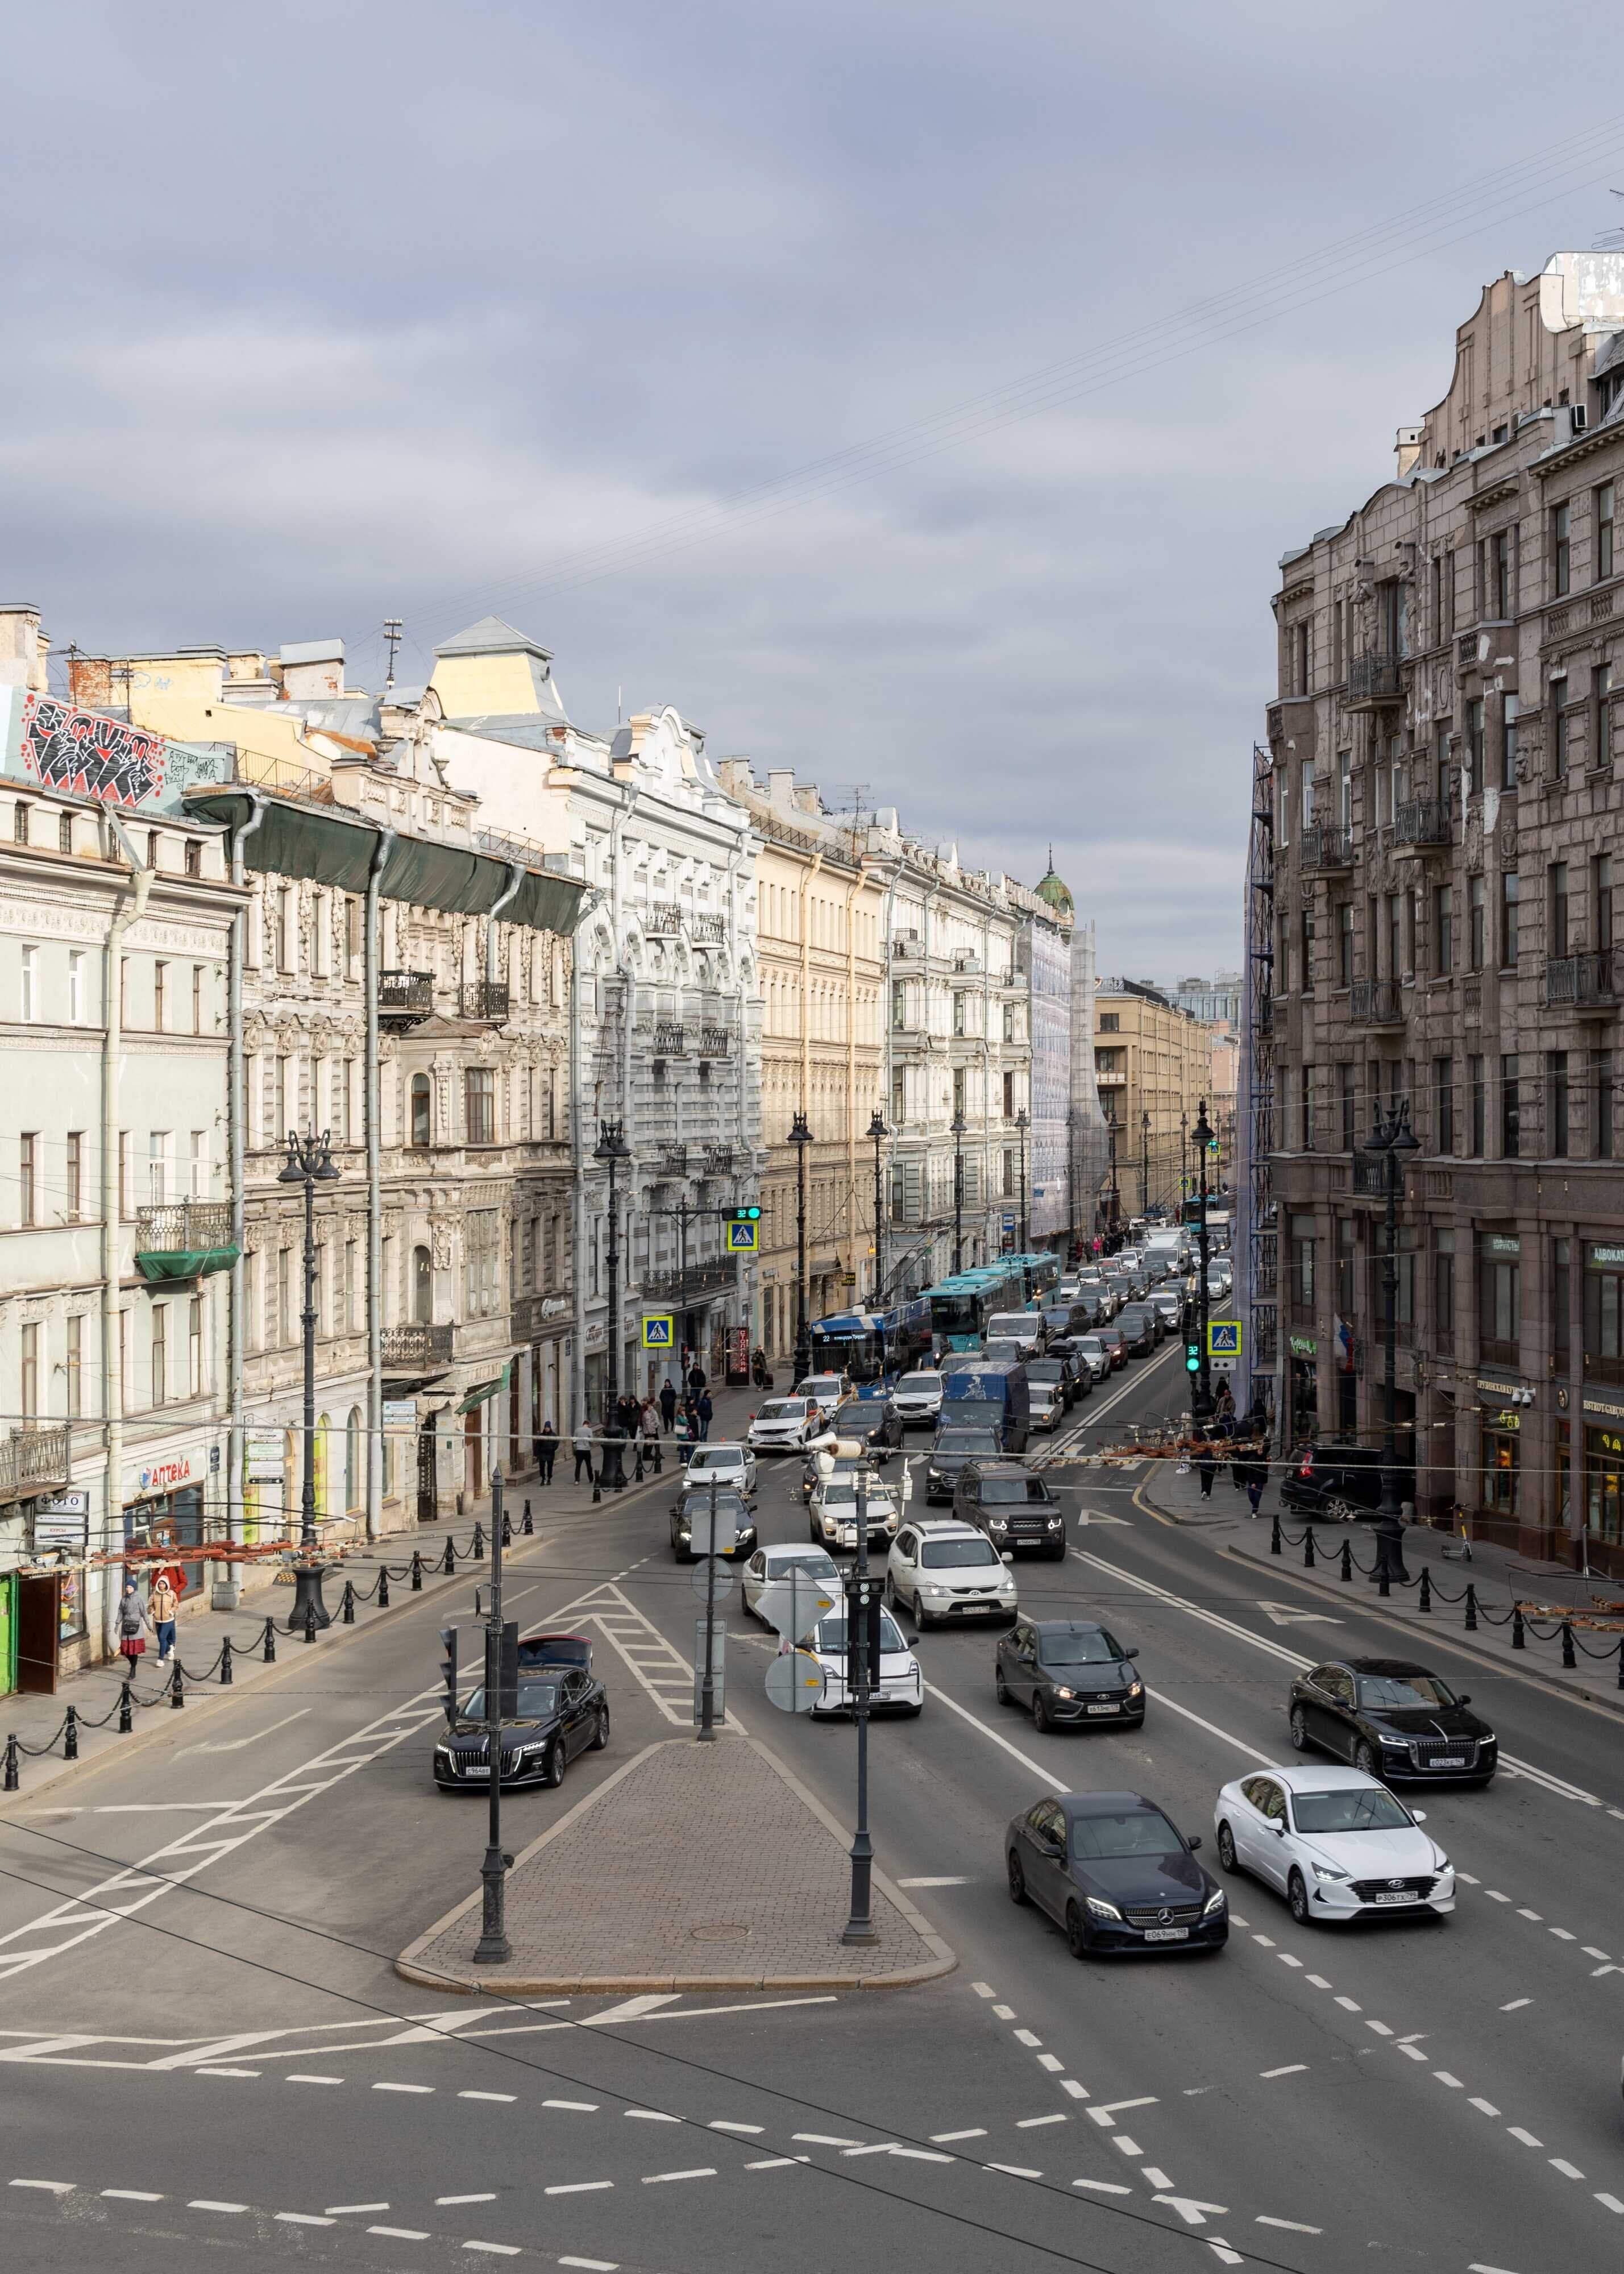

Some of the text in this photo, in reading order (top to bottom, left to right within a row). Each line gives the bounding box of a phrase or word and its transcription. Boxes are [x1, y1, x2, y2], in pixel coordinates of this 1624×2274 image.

[1189, 1346, 1198, 1355] 32
[152, 1460, 190, 1486] АПТЕКА
[41, 1497, 78, 1506] ФОТО
